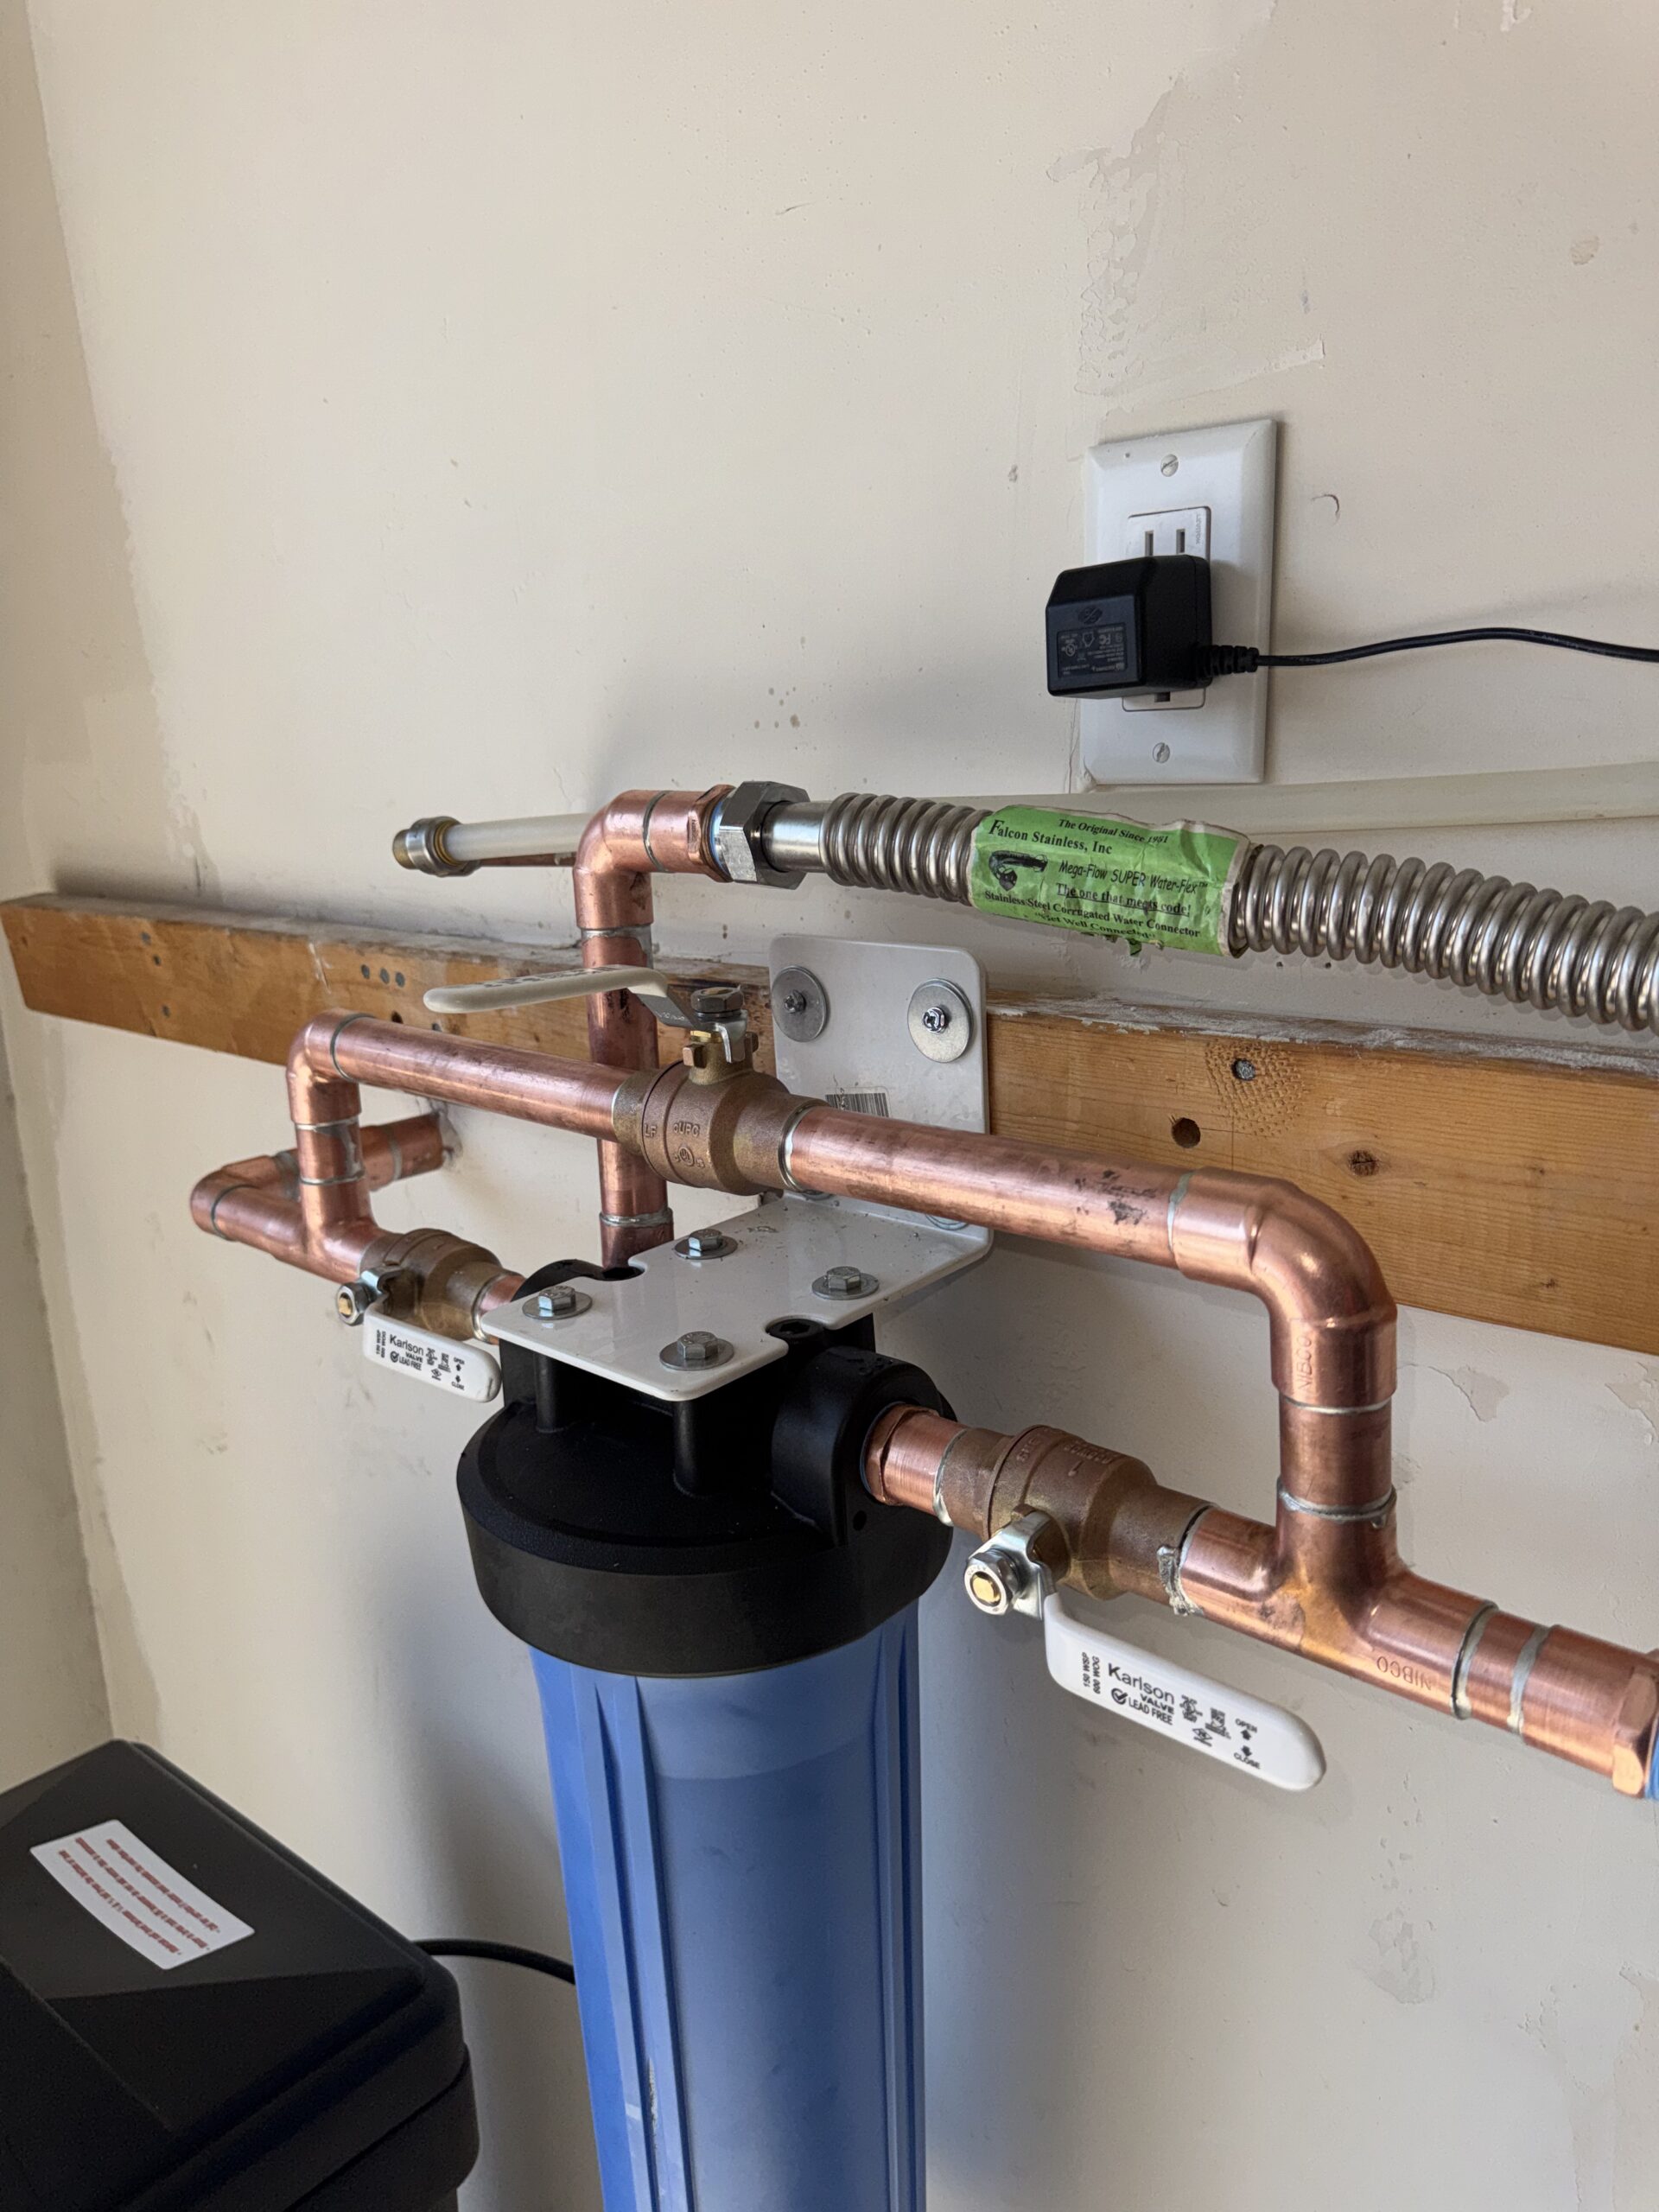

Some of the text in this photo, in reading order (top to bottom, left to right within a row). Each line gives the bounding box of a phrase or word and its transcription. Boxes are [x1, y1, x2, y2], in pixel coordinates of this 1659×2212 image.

[988, 819, 1113, 855] Falcon Stainless, Inc
[1058, 818, 1076, 830] The
[1077, 822, 1118, 836] Original
[1118, 829, 1145, 842] Since
[1058, 860, 1108, 880] Mega-Flow
[1110, 868, 1147, 887] SUPER
[1056, 882, 1192, 916] The one that meets code!
[985, 890, 1201, 938] Stainless Steel Corrugated Water Connector
[1062, 916, 1088, 928] Well
[390, 1333, 423, 1357] Karlson
[405, 1351, 423, 1363] VALVE
[1108, 1662, 1174, 1705] Karlson
[1376, 1656, 1431, 1691] NIBCO
[1092, 1679, 1101, 1694] 600
[1128, 1696, 1150, 1715] LEAD
[1151, 1707, 1173, 1726] FREE
[1140, 1693, 1175, 1715] VALVE
[1235, 1718, 1257, 1733] OPEN
[1233, 1751, 1261, 1770] CLOSE
